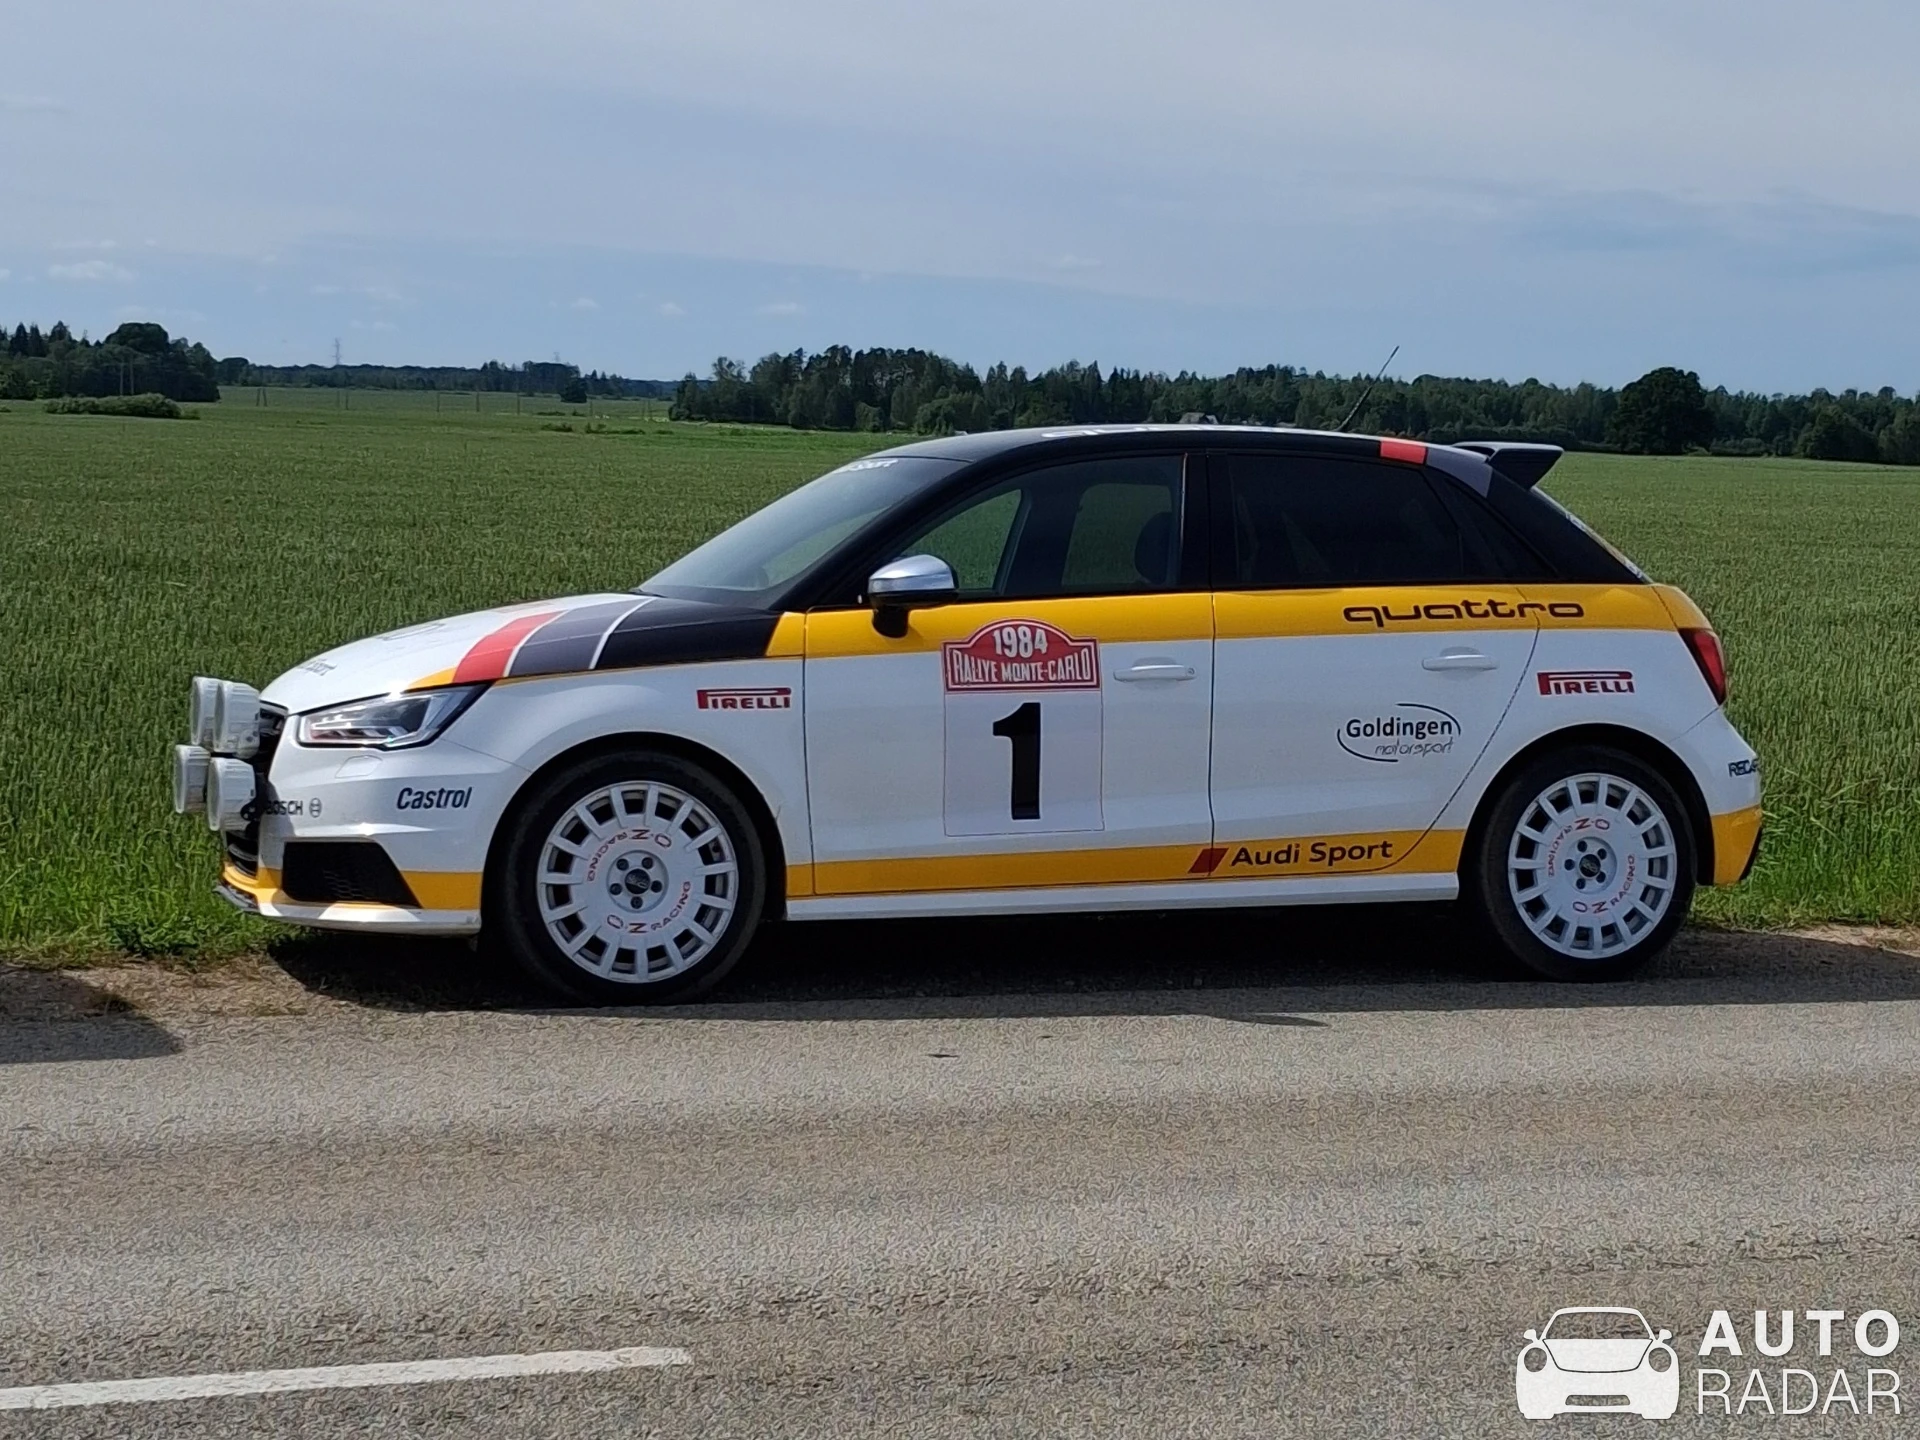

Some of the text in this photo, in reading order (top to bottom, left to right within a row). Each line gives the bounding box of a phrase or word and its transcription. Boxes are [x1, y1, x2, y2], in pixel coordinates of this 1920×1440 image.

[1343, 599, 1584, 628] quattro
[993, 625, 1048, 658] 1984
[953, 648, 1092, 683] RALLYE MONTE-CARLO
[1537, 671, 1635, 695] PIRELLI
[696, 687, 791, 709] PIRELLI
[1346, 716, 1452, 740] Goldingen
[1375, 736, 1454, 758] motorsport
[993, 702, 1041, 820] 1
[396, 786, 473, 810] Castrol
[1231, 840, 1393, 866] Audi Sport
[650, 881, 691, 931] RACING
